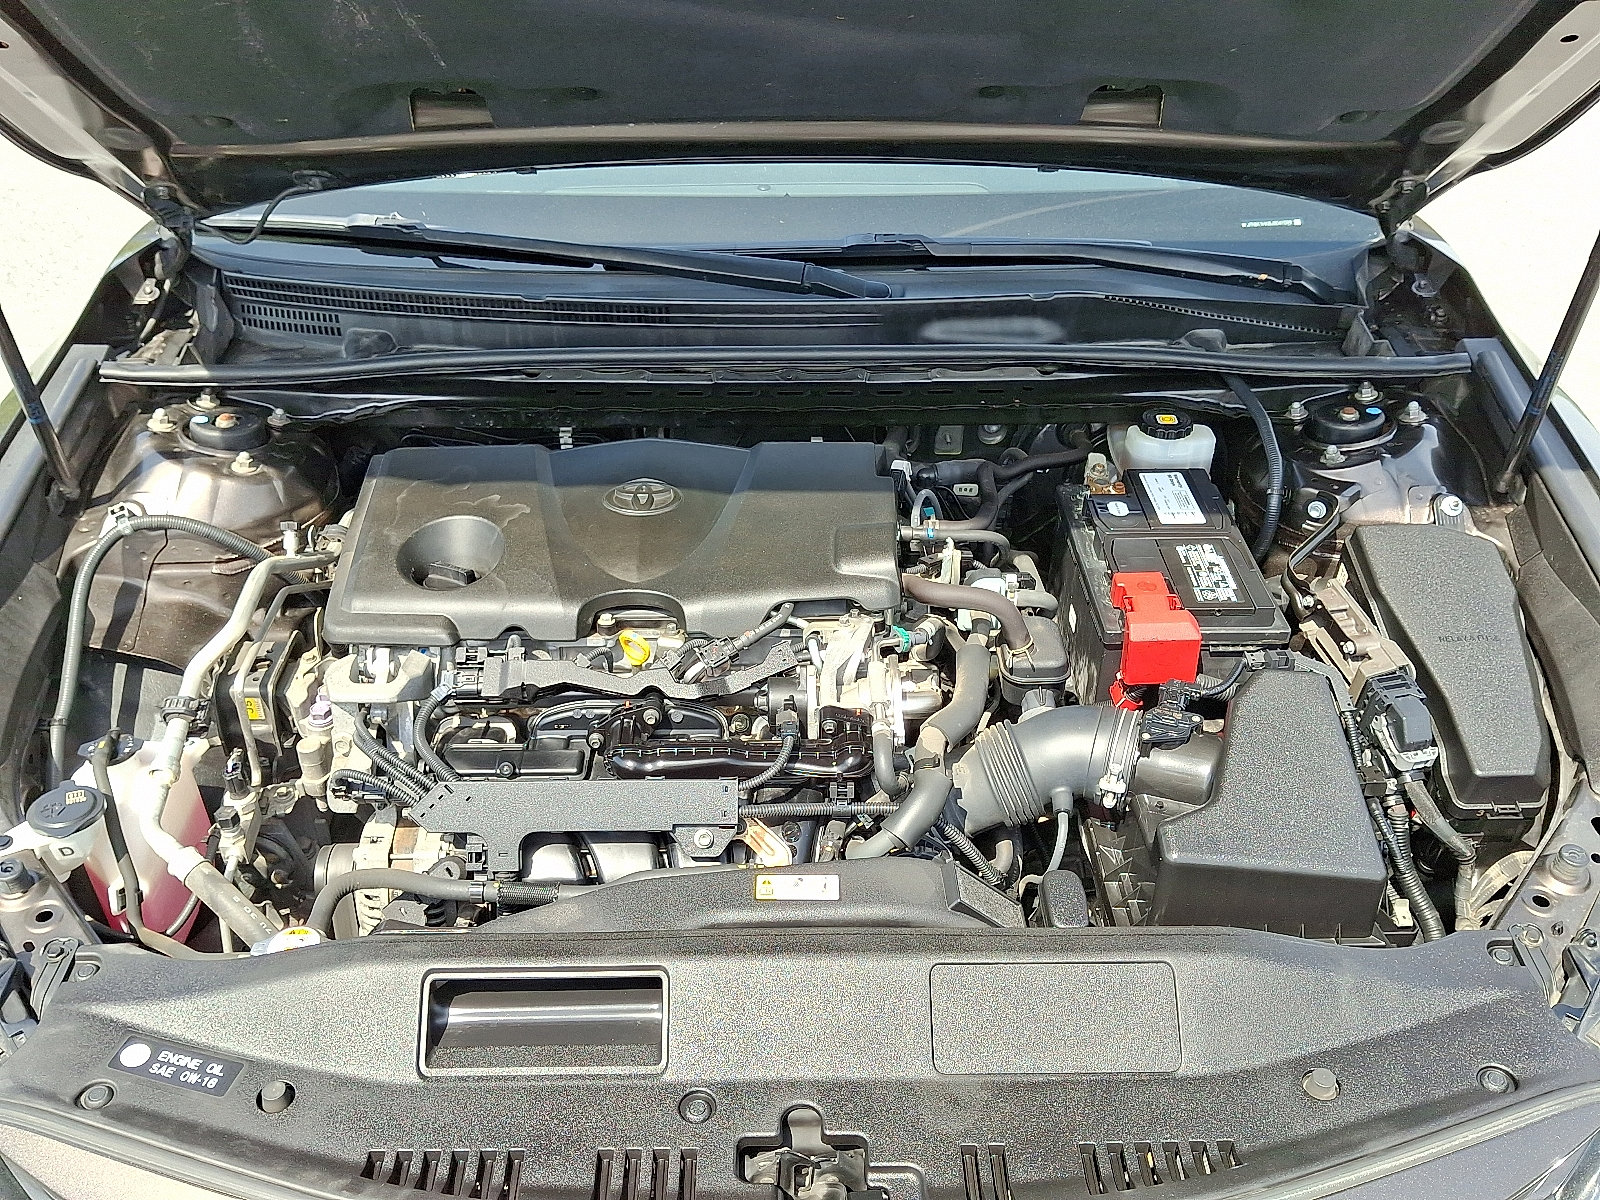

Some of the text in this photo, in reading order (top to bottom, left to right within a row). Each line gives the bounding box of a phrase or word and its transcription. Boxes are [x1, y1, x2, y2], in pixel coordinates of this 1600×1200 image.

[148, 1063, 177, 1079] SAE
[157, 1050, 224, 1077] ENGINE OIL
